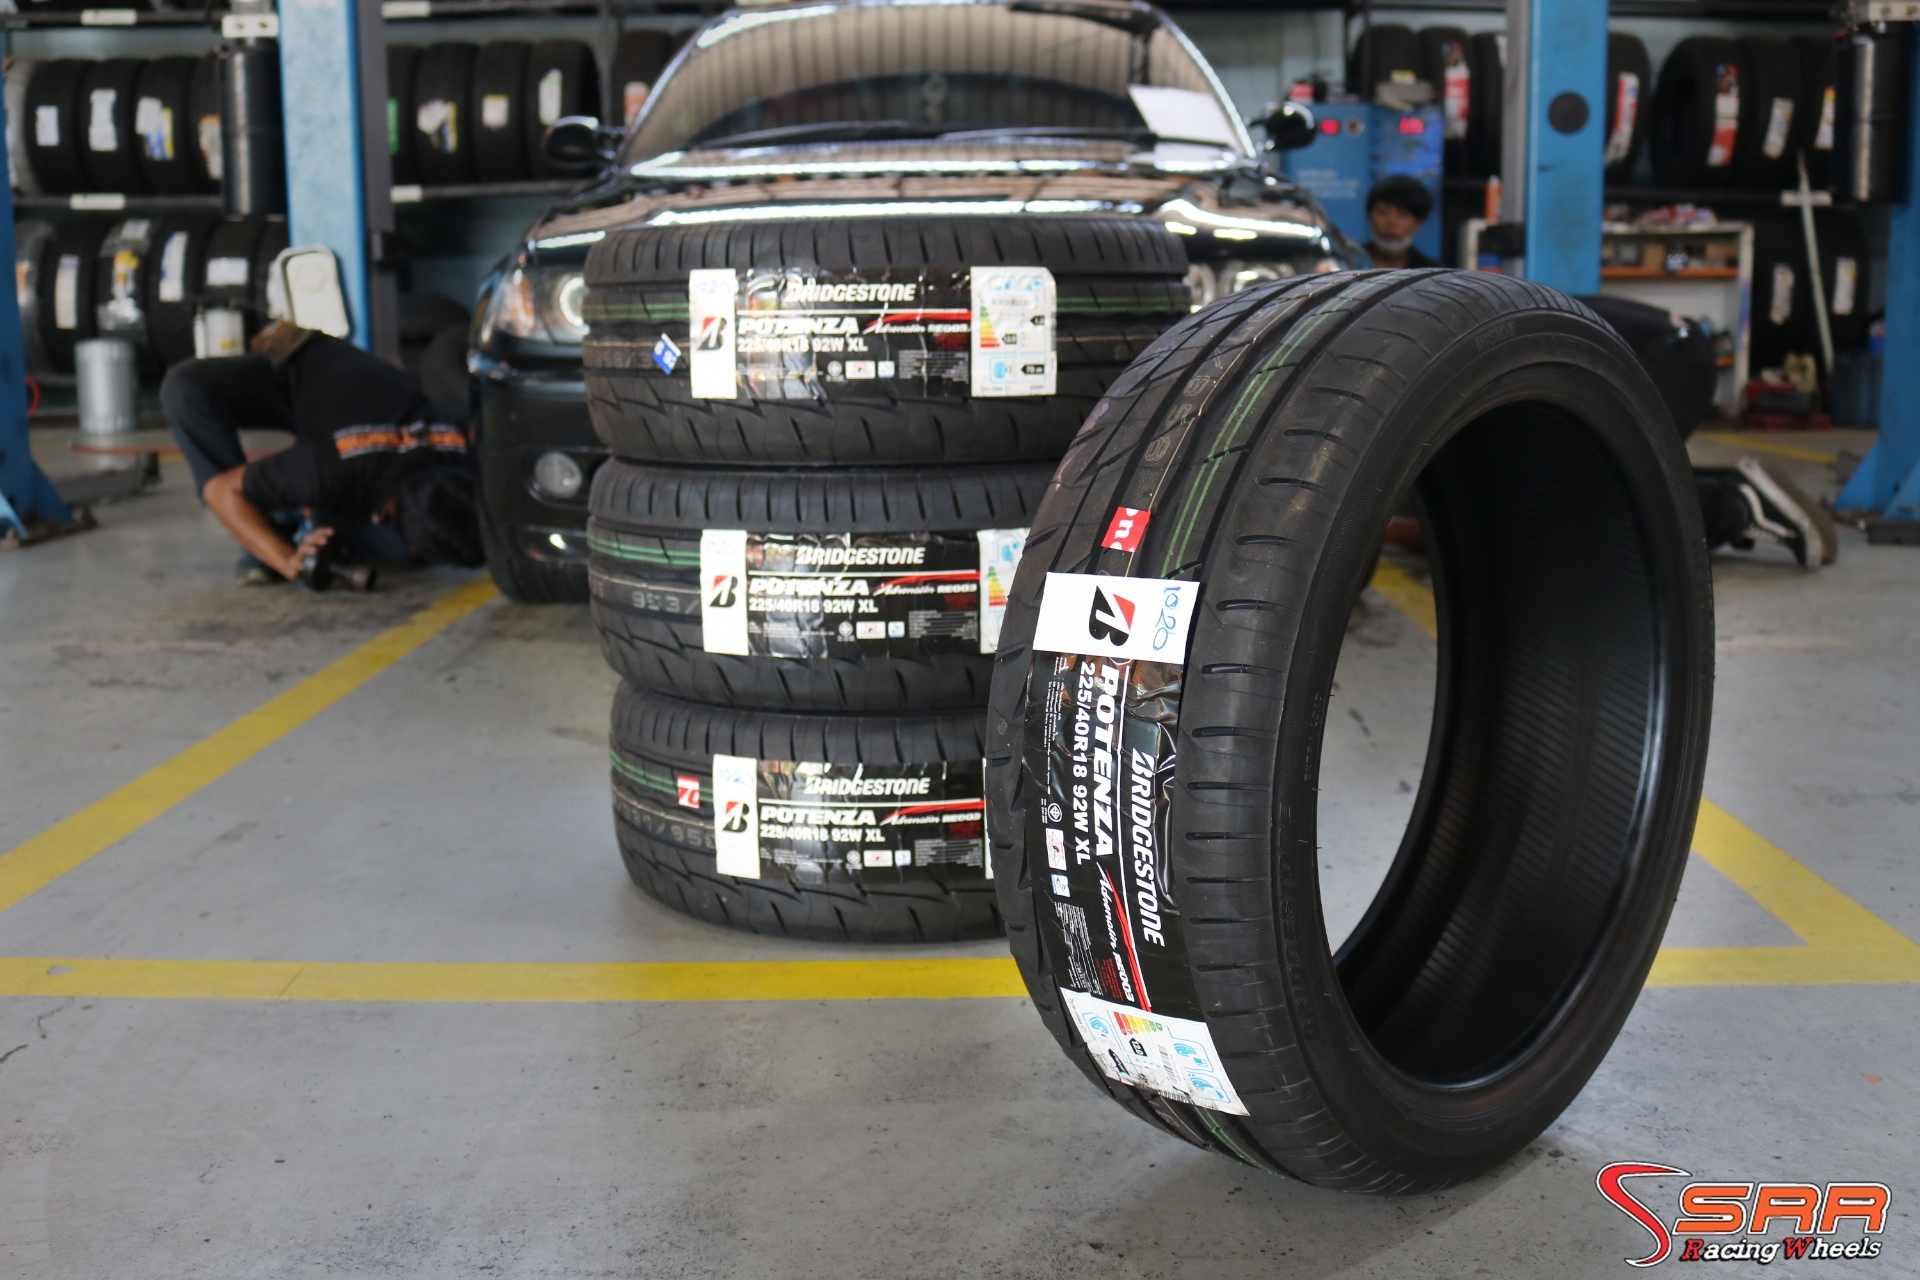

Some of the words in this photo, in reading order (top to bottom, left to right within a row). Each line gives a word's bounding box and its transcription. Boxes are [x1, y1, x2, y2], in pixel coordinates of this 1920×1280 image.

[787, 283, 916, 303] BRIDGESTONE
[738, 316, 859, 335] POTENZA
[812, 338, 846, 353] 92W
[847, 338, 868, 353] XL
[795, 546, 925, 566] BRIDGESTONE
[749, 578, 869, 597] POTENZA
[748, 598, 821, 613] 225/40R18
[823, 598, 856, 613] 92W
[857, 599, 879, 614] XL
[1071, 661, 1096, 780] 225/40R18
[1092, 663, 1120, 857] POTENZA
[804, 776, 931, 796] BRIDGESTONE
[759, 807, 876, 827] POTENZA
[1071, 784, 1091, 839] 92W
[760, 826, 829, 841] 225/40R18
[831, 827, 864, 842] 92W
[865, 828, 886, 843] XL
[1075, 839, 1091, 866] XL
[1131, 747, 1166, 947] BRIDGESTONE
[1095, 861, 1120, 952] Adrenalin
[1111, 951, 1135, 1003] RE003
